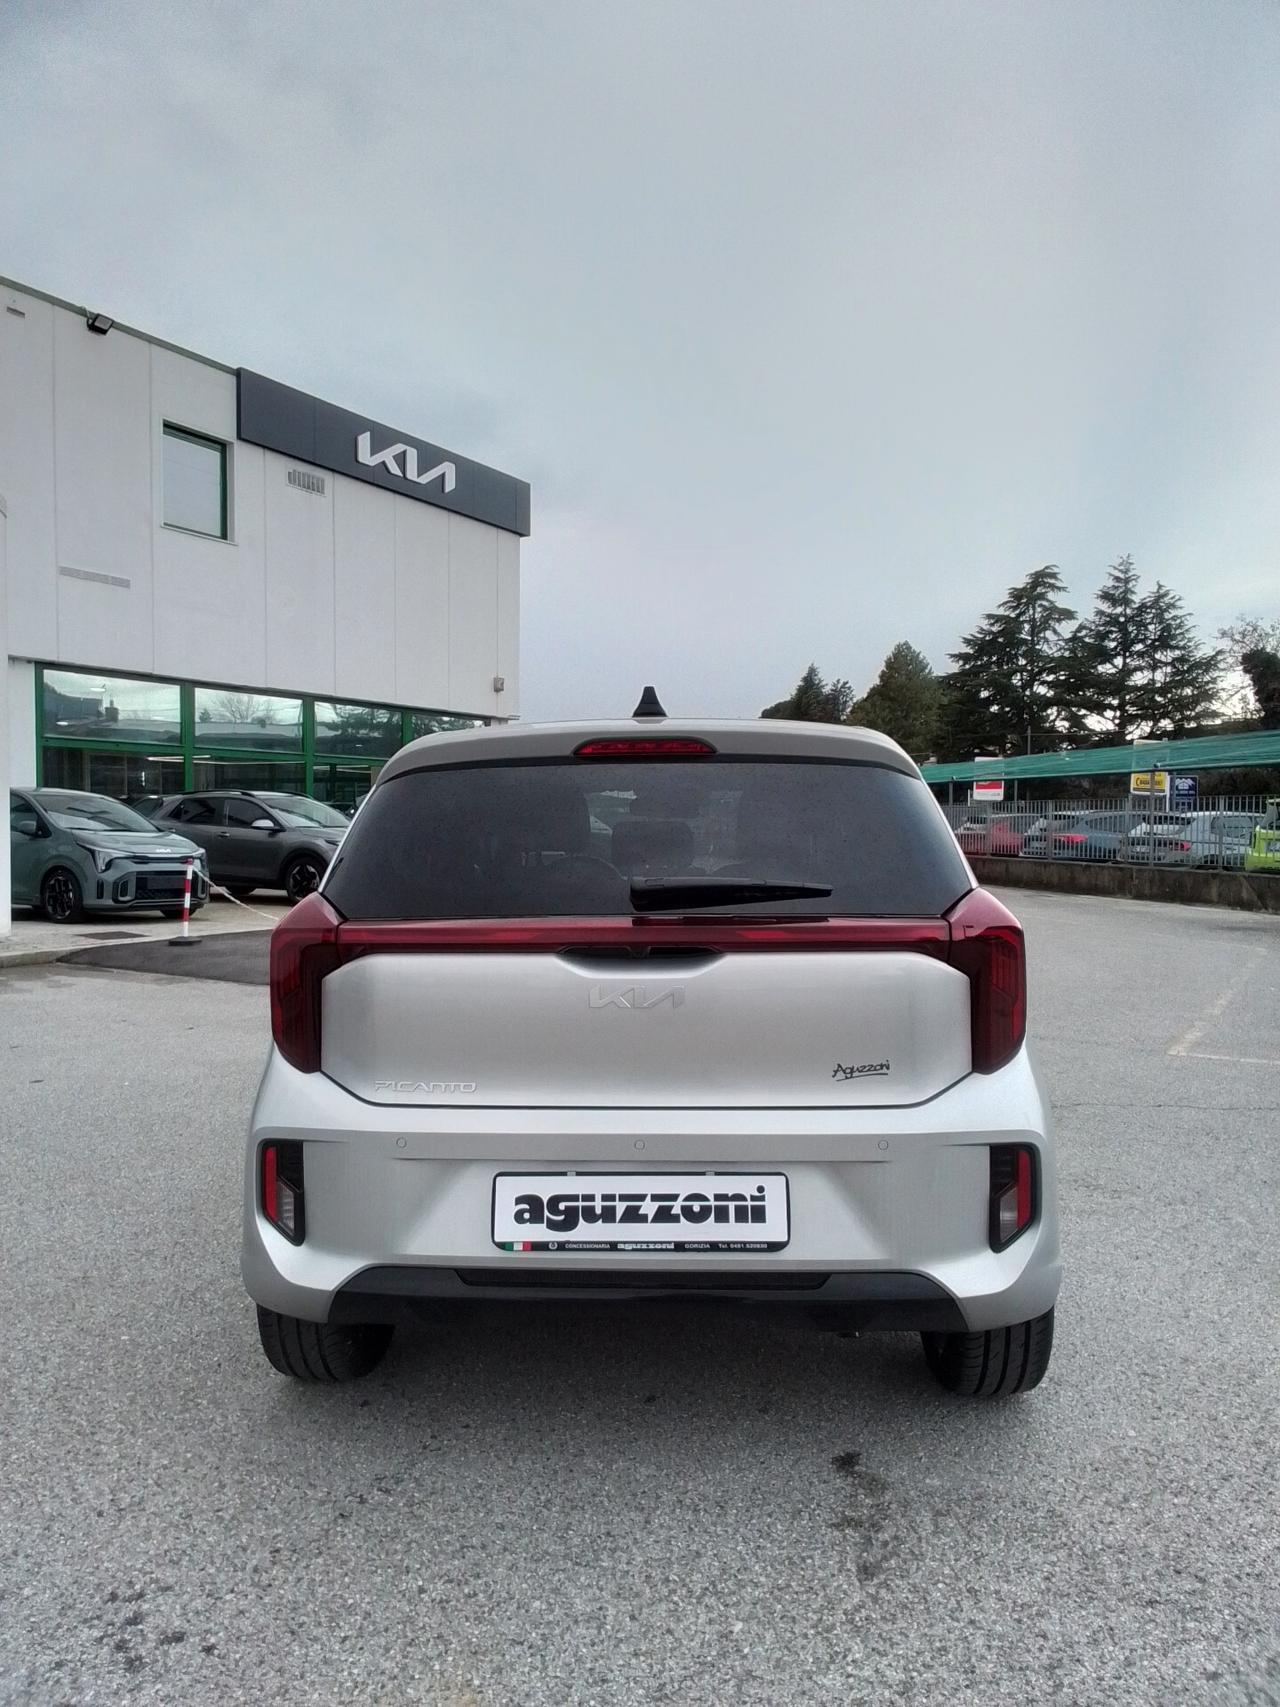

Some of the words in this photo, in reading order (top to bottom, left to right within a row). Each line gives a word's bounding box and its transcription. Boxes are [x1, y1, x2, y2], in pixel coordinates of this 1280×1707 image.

[357, 431, 456, 494] KIA
[588, 985, 685, 1009] KIA
[831, 1058, 890, 1081] Aguzzoni
[375, 1080, 477, 1094] PICANTO
[513, 1184, 767, 1233] aguzzoni
